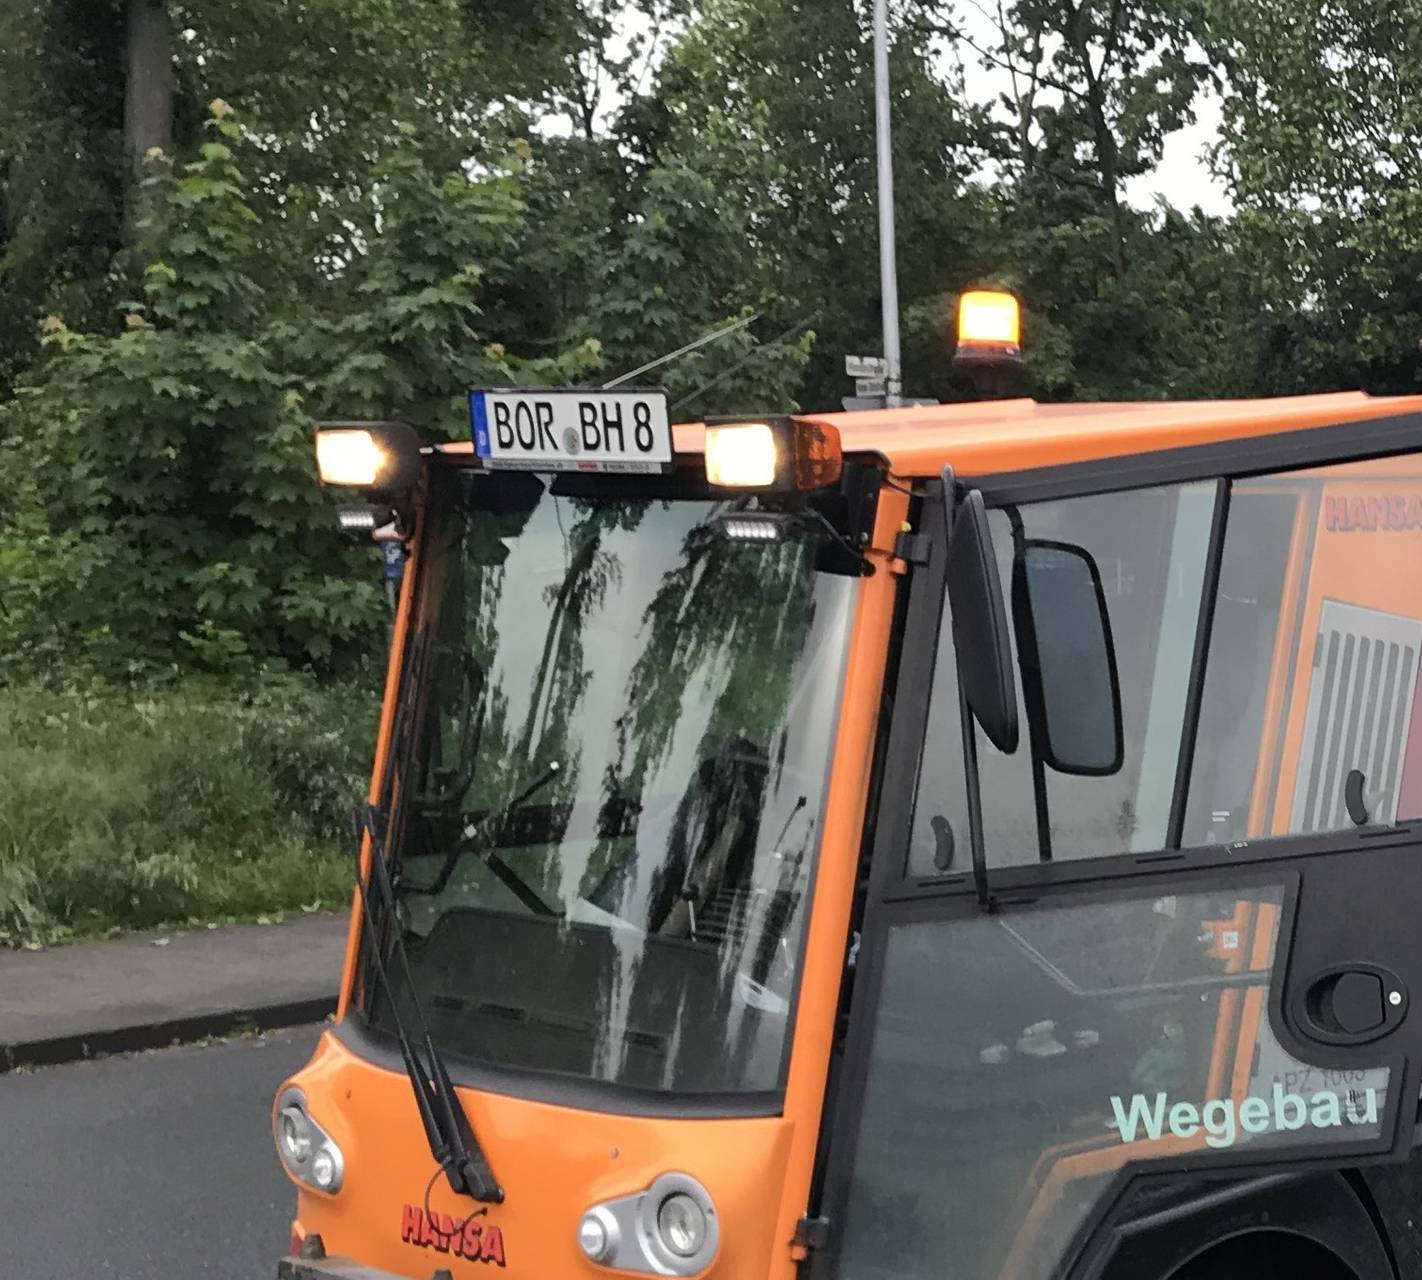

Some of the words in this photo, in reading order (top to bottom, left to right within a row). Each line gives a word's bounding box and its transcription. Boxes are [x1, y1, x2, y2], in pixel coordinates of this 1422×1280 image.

[493, 400, 559, 451] BOR
[578, 401, 625, 452] BH
[633, 401, 654, 452] 8
[1109, 1082, 1378, 1148] Wegebau
[402, 1204, 506, 1268] HANSA
